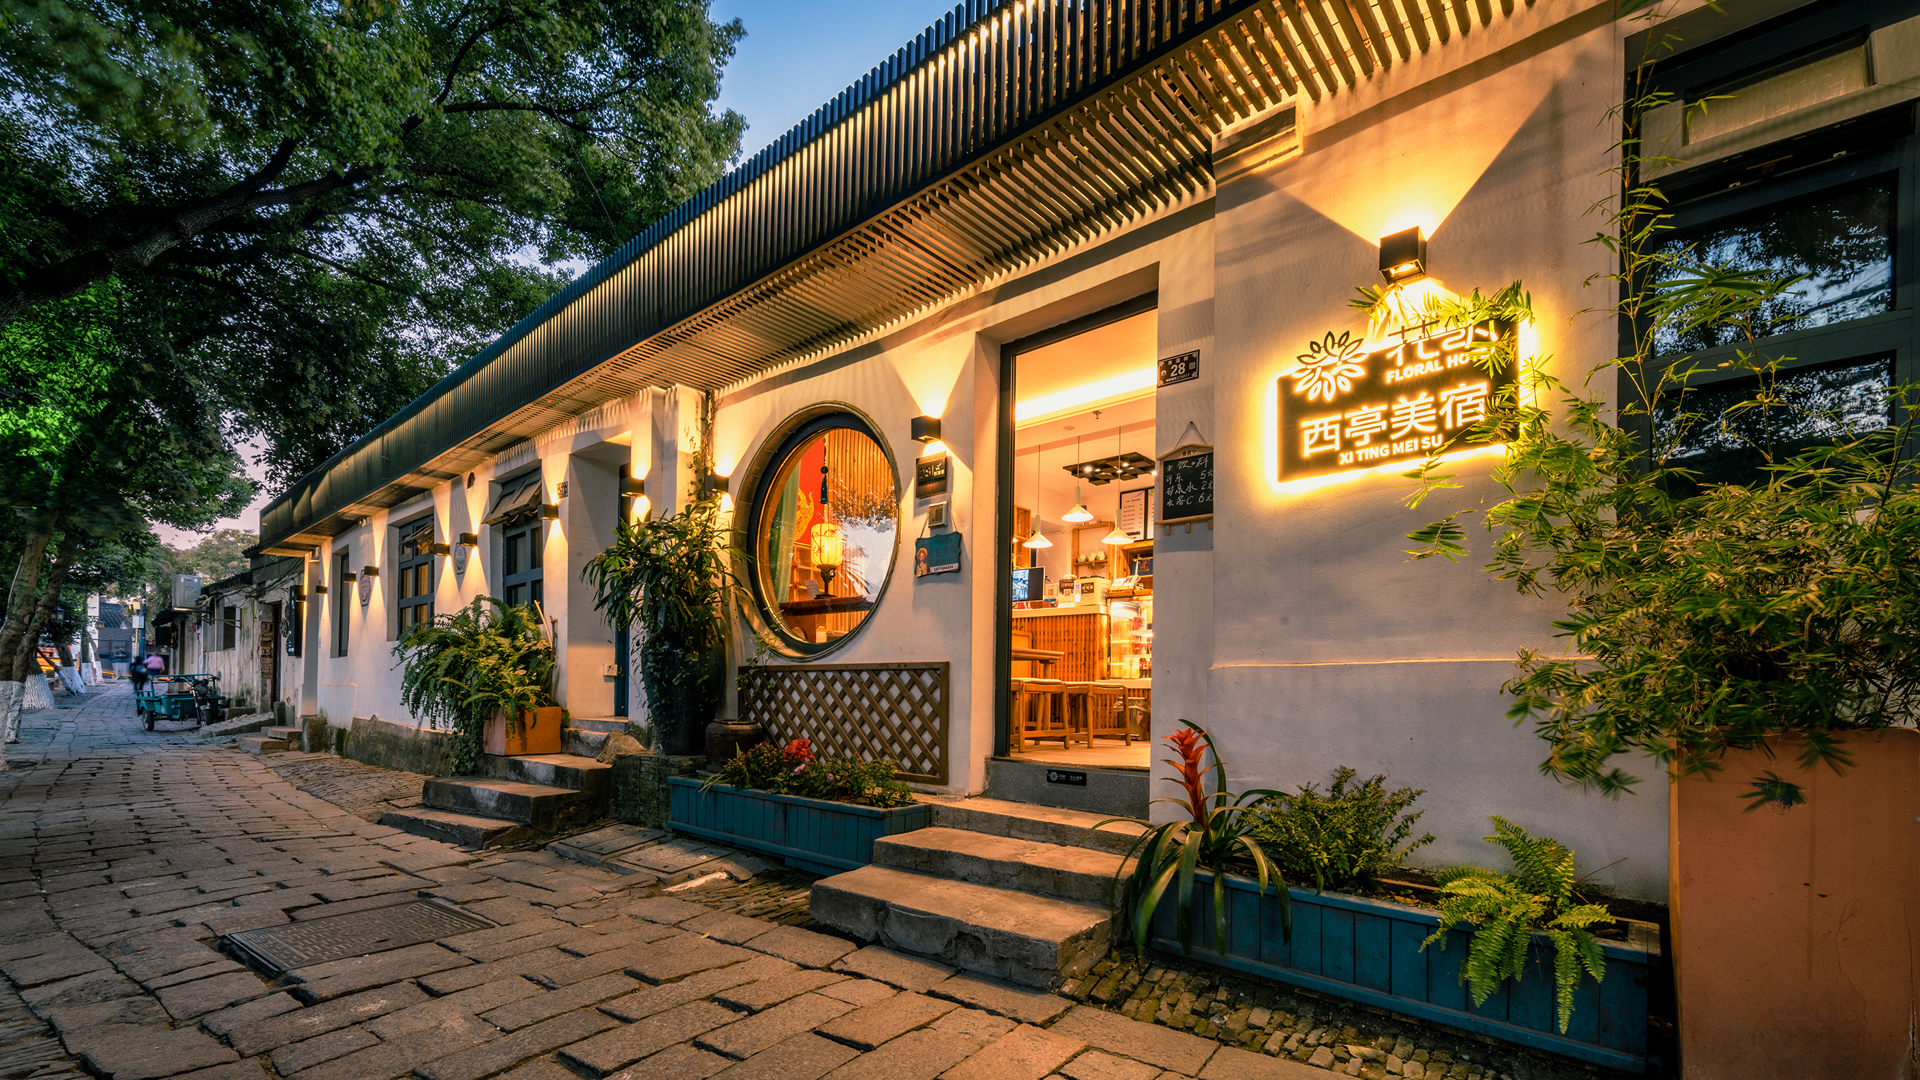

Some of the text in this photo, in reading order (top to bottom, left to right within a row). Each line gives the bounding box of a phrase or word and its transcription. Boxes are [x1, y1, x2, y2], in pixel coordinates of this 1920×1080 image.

[1170, 362, 1186, 377] 28
[1386, 360, 1444, 383] FLORAL
[1301, 382, 1488, 456] 西亭美宿
[1339, 434, 1443, 465] XI TING MEI SU
